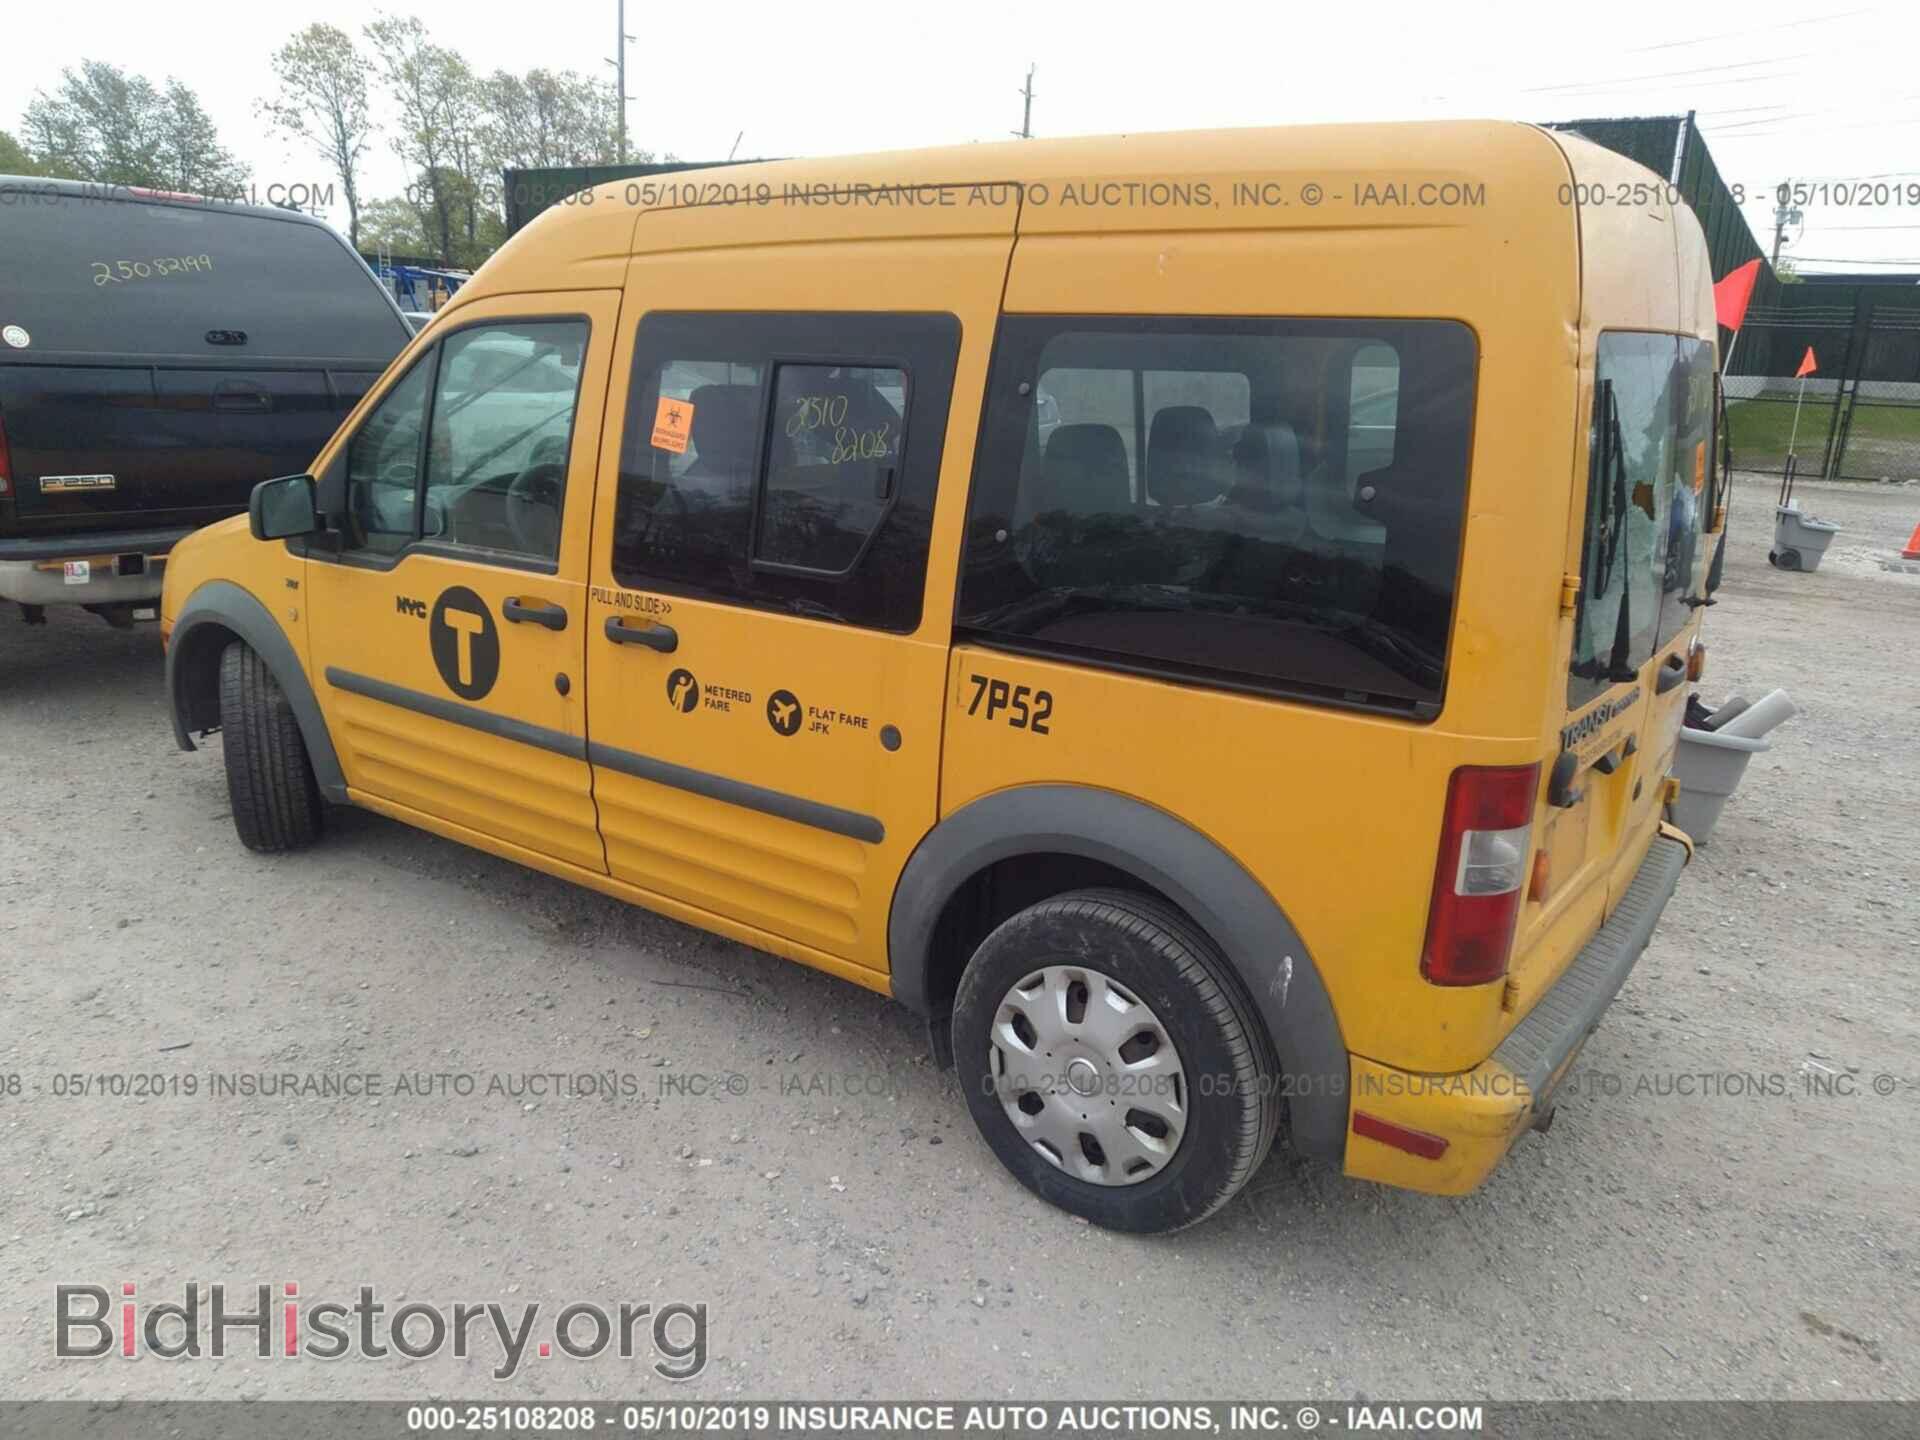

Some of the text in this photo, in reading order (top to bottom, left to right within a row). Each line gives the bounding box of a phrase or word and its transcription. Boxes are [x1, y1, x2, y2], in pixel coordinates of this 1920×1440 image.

[91, 254, 212, 286] 25082199
[396, 596, 427, 619] NYC
[592, 587, 660, 614] PULL AND SLIDE
[444, 607, 484, 687] T
[704, 684, 752, 704] METERED
[704, 698, 731, 712] FARE
[968, 674, 1053, 735] 7P52
[808, 707, 869, 729] FLAT FARE
[809, 721, 830, 735] JFK
